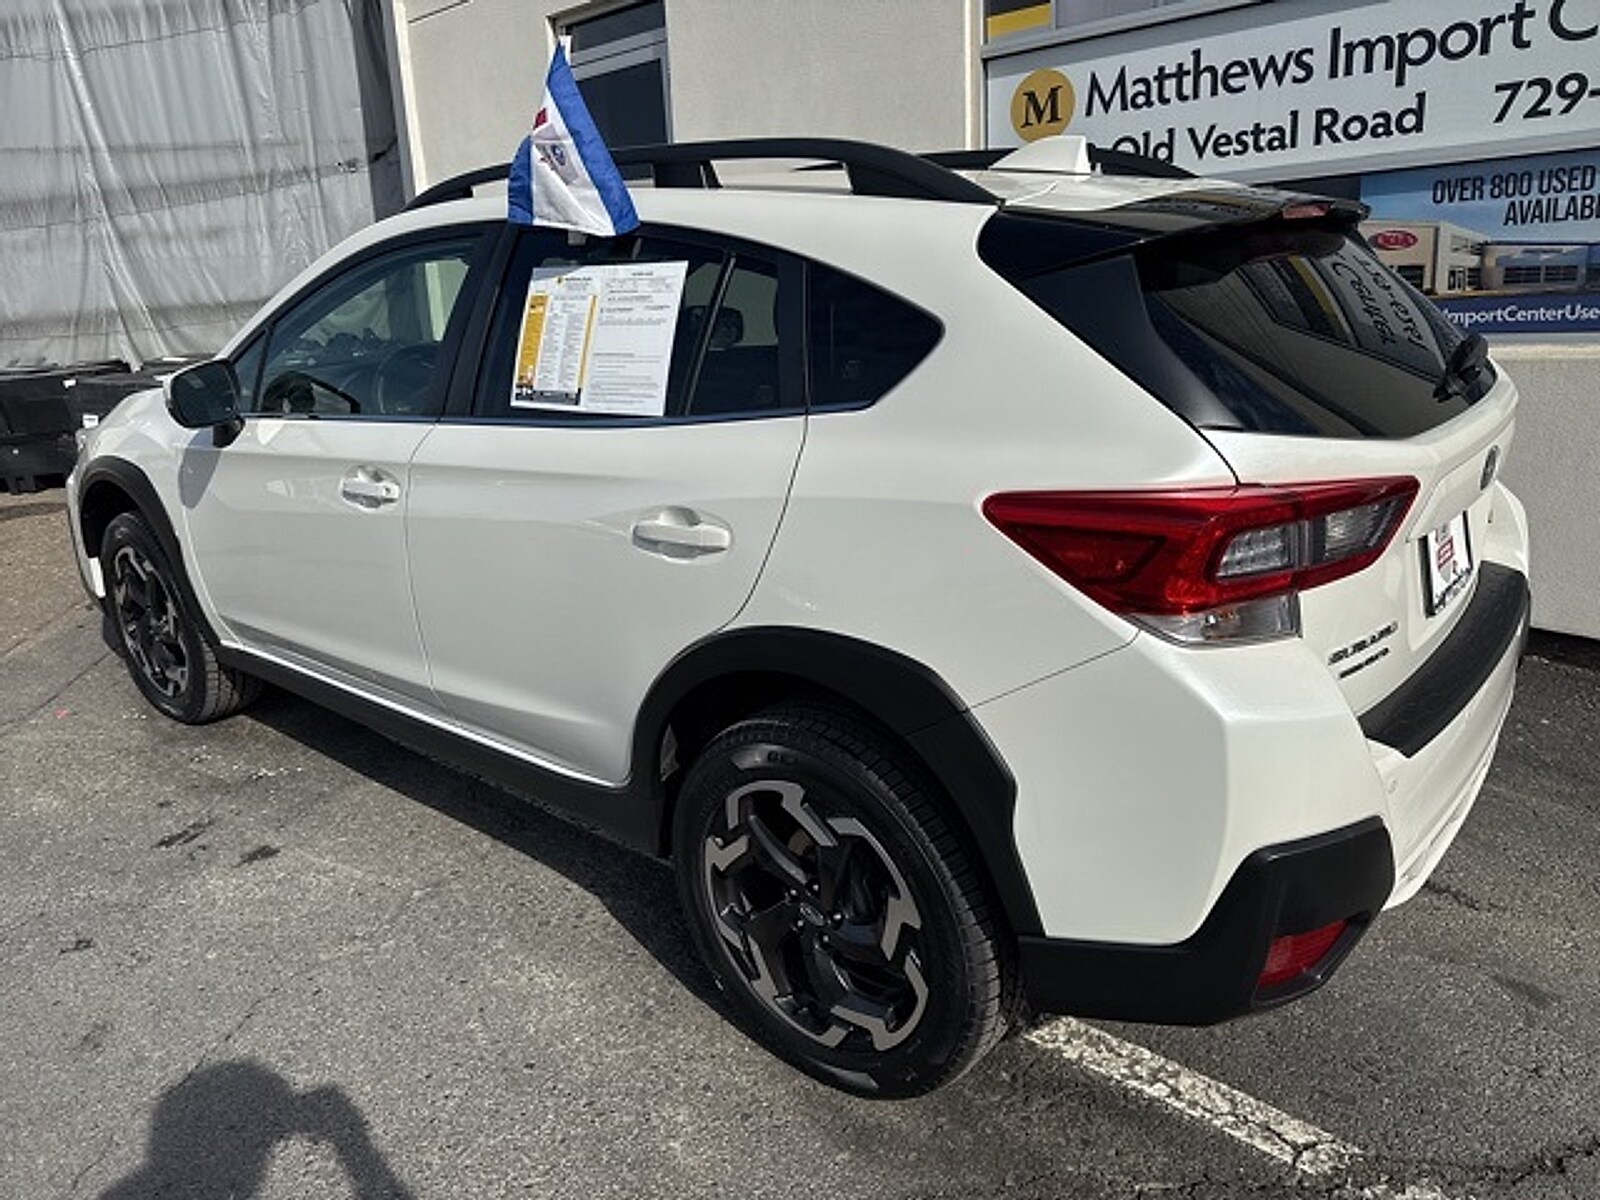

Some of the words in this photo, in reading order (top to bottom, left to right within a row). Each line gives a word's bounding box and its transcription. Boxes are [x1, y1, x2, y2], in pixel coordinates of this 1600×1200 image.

[1084, 48, 1315, 117] Matthews
[1328, 0, 1536, 88] Import
[1020, 84, 1064, 129] M
[1493, 72, 1600, 123] 729-
[1187, 110, 1299, 160] Vestal
[1312, 91, 1426, 146] Road
[1432, 177, 1484, 204] OVER
[1490, 171, 1533, 198] 800
[1538, 165, 1596, 195] USED
